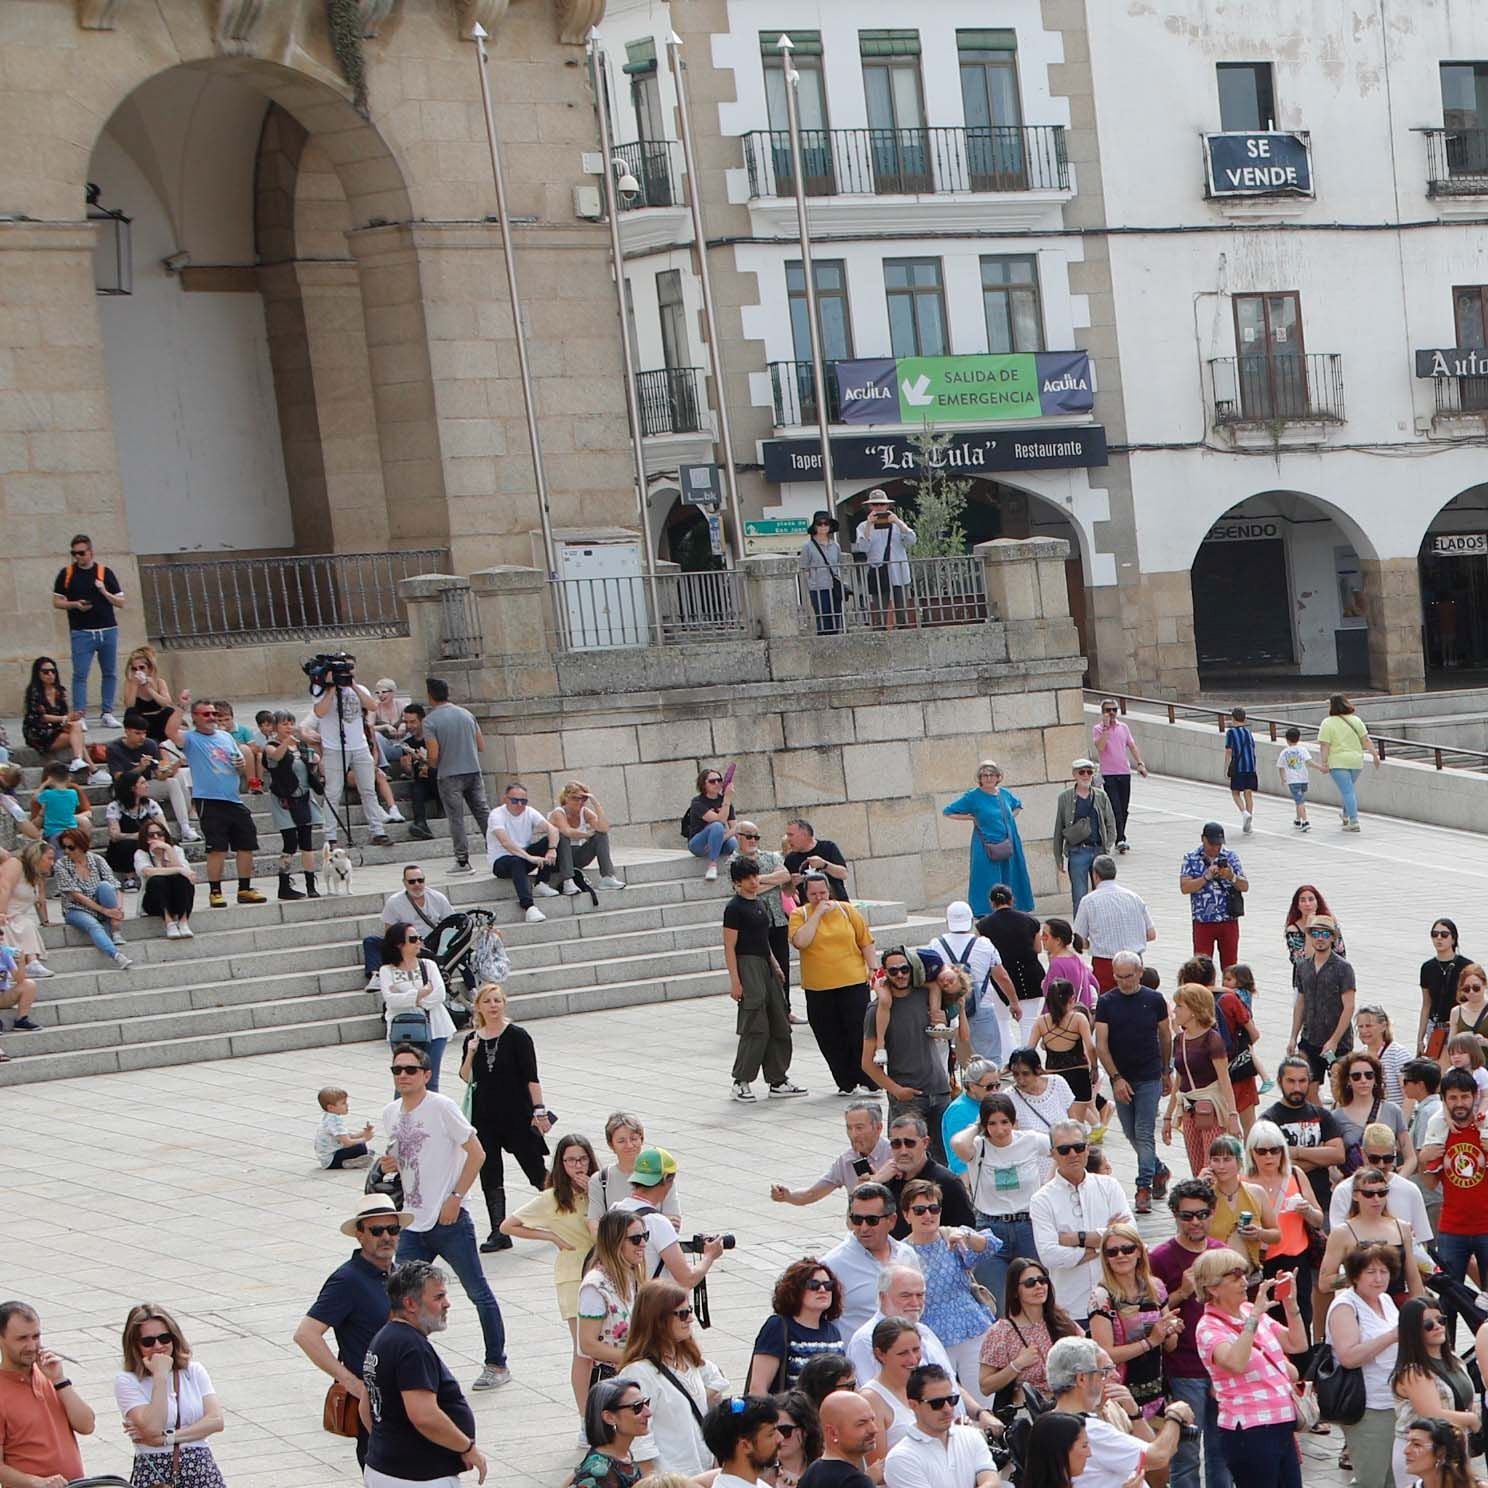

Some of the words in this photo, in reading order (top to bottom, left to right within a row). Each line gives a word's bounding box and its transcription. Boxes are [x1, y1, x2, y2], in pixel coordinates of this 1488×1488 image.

[1246, 139, 1271, 158] SE
[1226, 167, 1298, 186] VENDE
[944, 370, 996, 384] SALIDA
[999, 369, 1019, 382] DE
[937, 391, 1036, 407] EMERGENCIA
[1014, 441, 1083, 460] Restaurante
